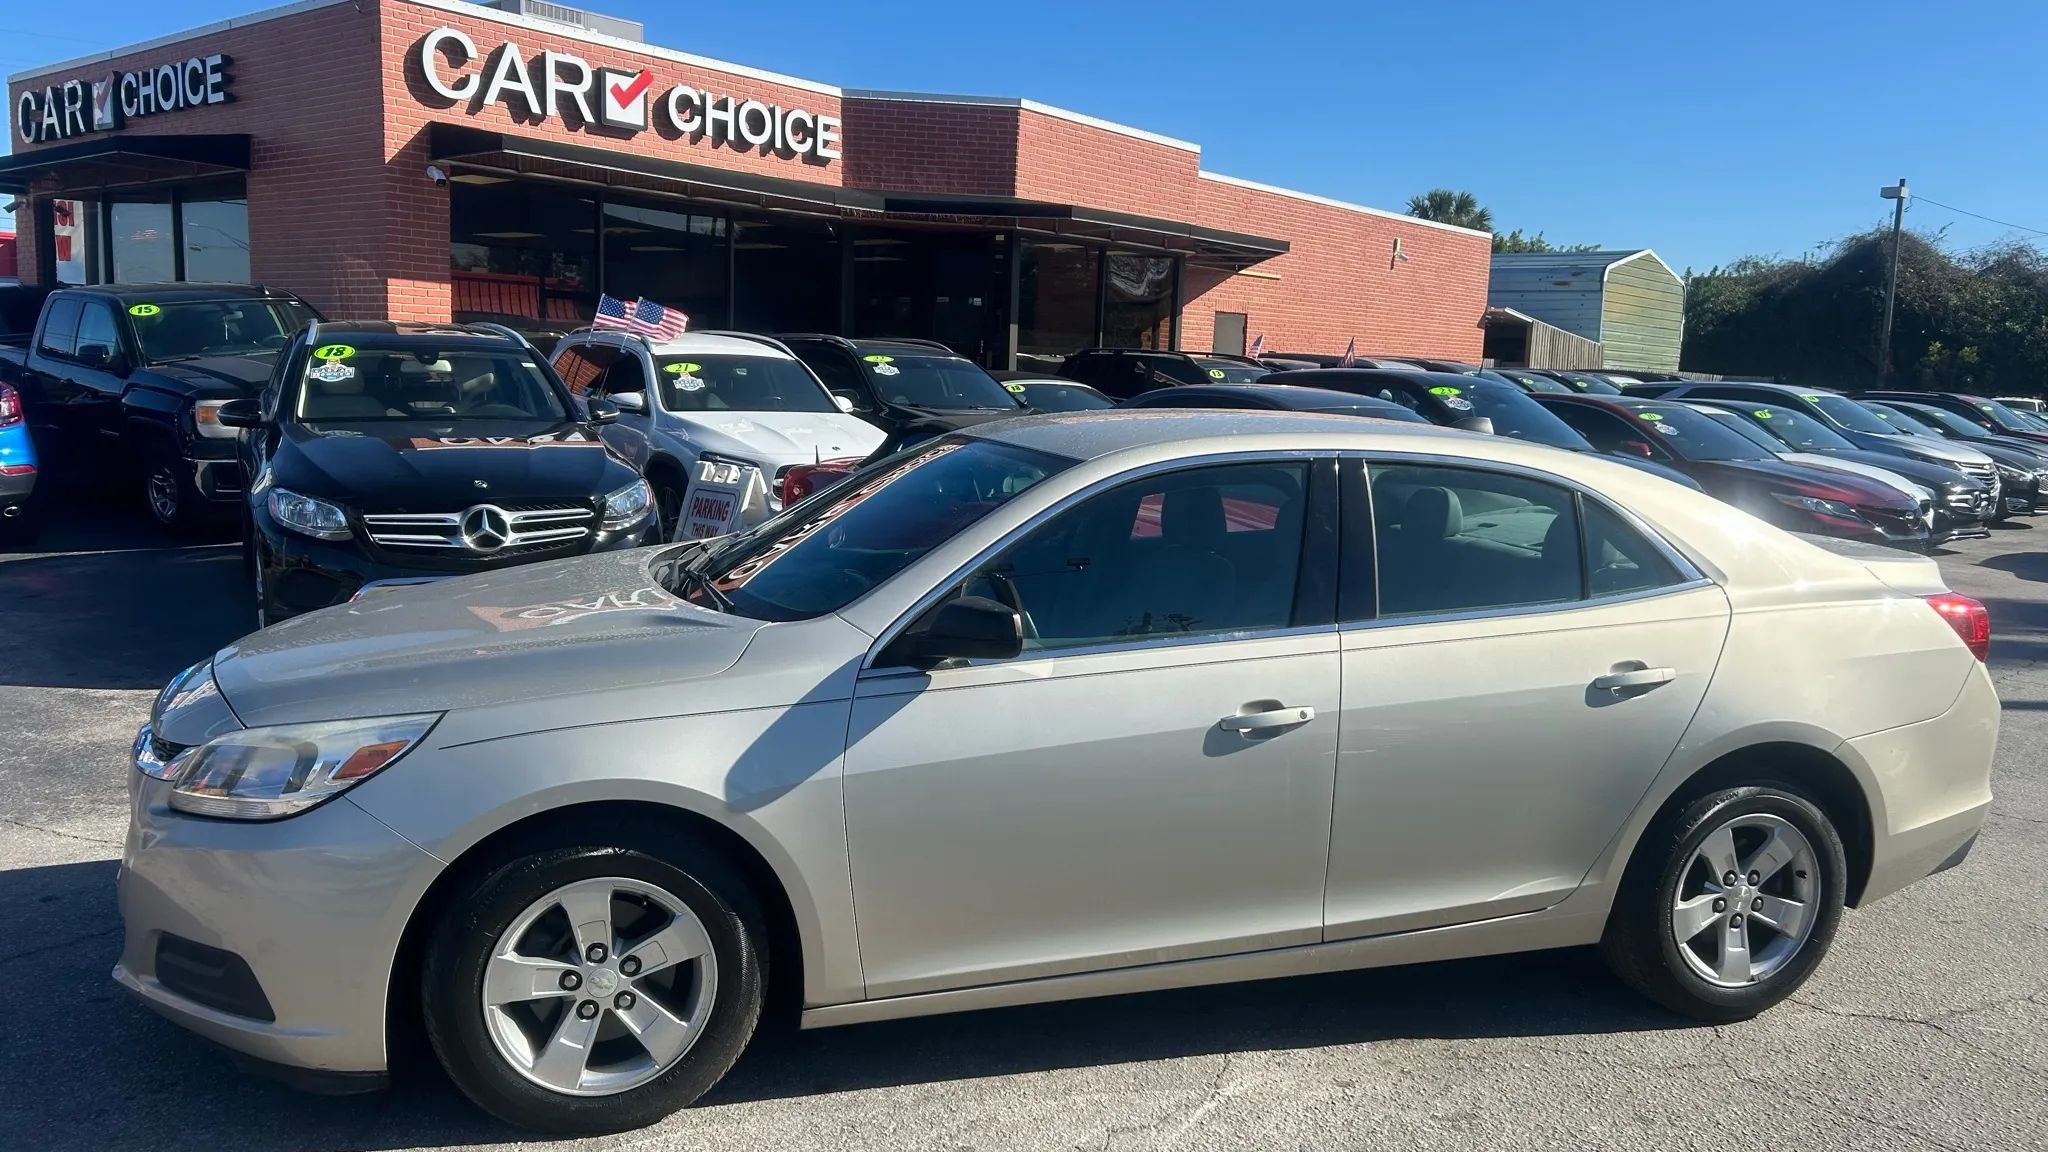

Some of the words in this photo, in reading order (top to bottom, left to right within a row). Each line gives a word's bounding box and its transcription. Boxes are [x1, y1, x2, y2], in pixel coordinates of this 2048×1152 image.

[18, 79, 86, 144] CAR
[121, 54, 225, 117] CHOICE
[422, 25, 595, 123] CAR
[668, 82, 841, 160] CHOICE
[137, 305, 152, 314] 15
[324, 347, 346, 357] 18
[691, 497, 730, 522] PARKING
[691, 523, 706, 538] THIS
[704, 525, 720, 540] WAY
